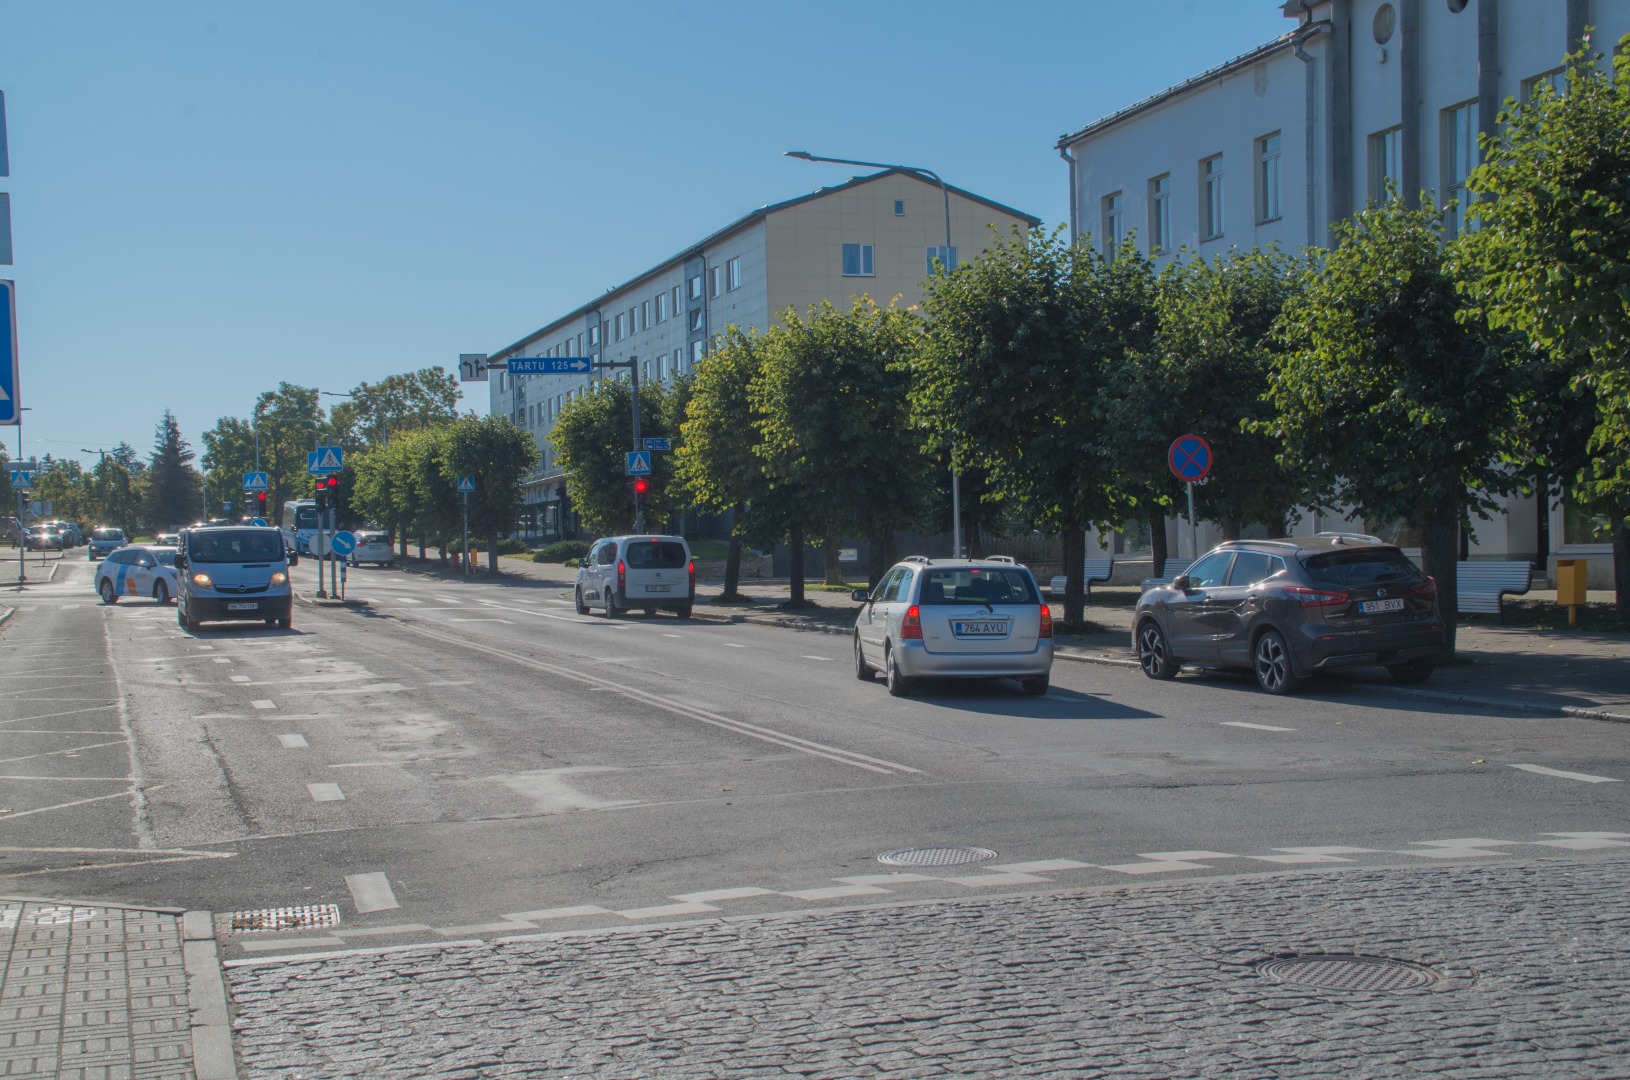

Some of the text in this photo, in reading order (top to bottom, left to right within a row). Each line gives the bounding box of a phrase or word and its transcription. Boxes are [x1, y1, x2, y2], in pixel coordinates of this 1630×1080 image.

[510, 361, 569, 371] TARTU 125
[1365, 600, 1401, 611] 951 BVX
[964, 624, 1004, 632] 764 AYU
